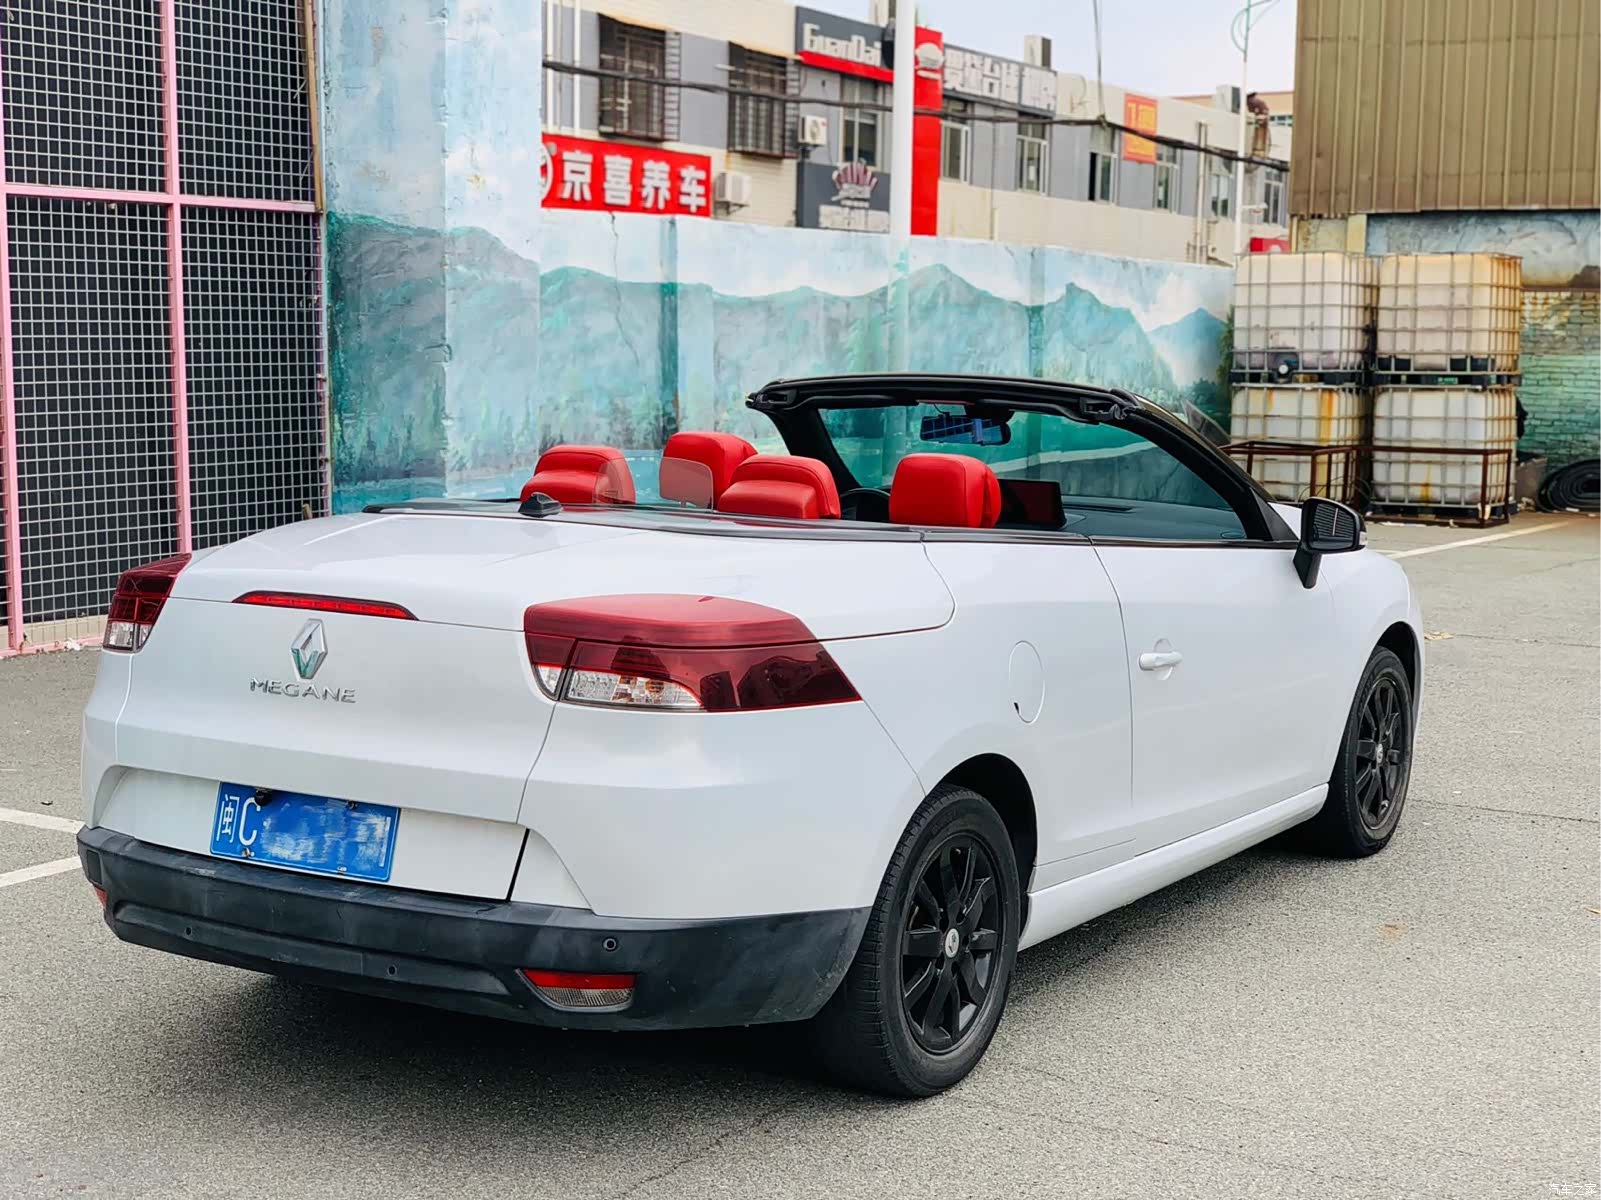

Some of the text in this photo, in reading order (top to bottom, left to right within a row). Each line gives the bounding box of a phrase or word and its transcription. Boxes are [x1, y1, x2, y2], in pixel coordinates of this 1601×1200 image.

[560, 150, 706, 213] 京喜养车
[250, 678, 356, 704] MEGANE
